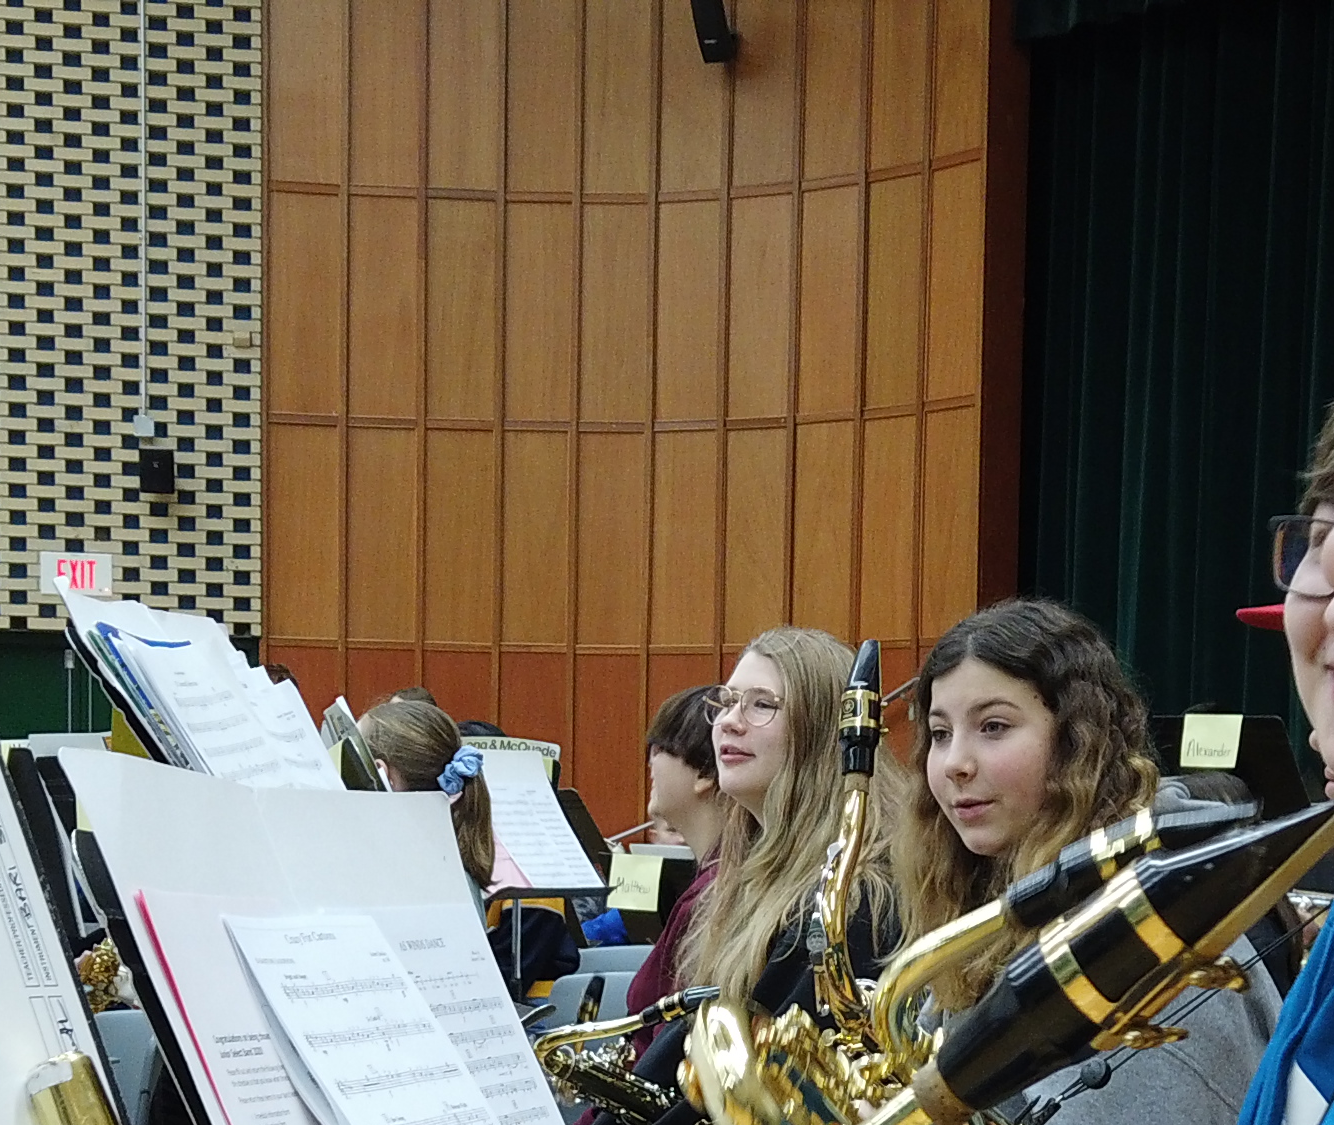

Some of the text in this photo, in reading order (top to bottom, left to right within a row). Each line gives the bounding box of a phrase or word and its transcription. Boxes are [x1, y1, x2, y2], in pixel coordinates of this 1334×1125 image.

[56, 559, 97, 590] EXIT
[489, 739, 498, 750] &
[1186, 738, 1232, 757] Alexander
[8, 864, 33, 920] BARI
[614, 876, 651, 894] Matthew
